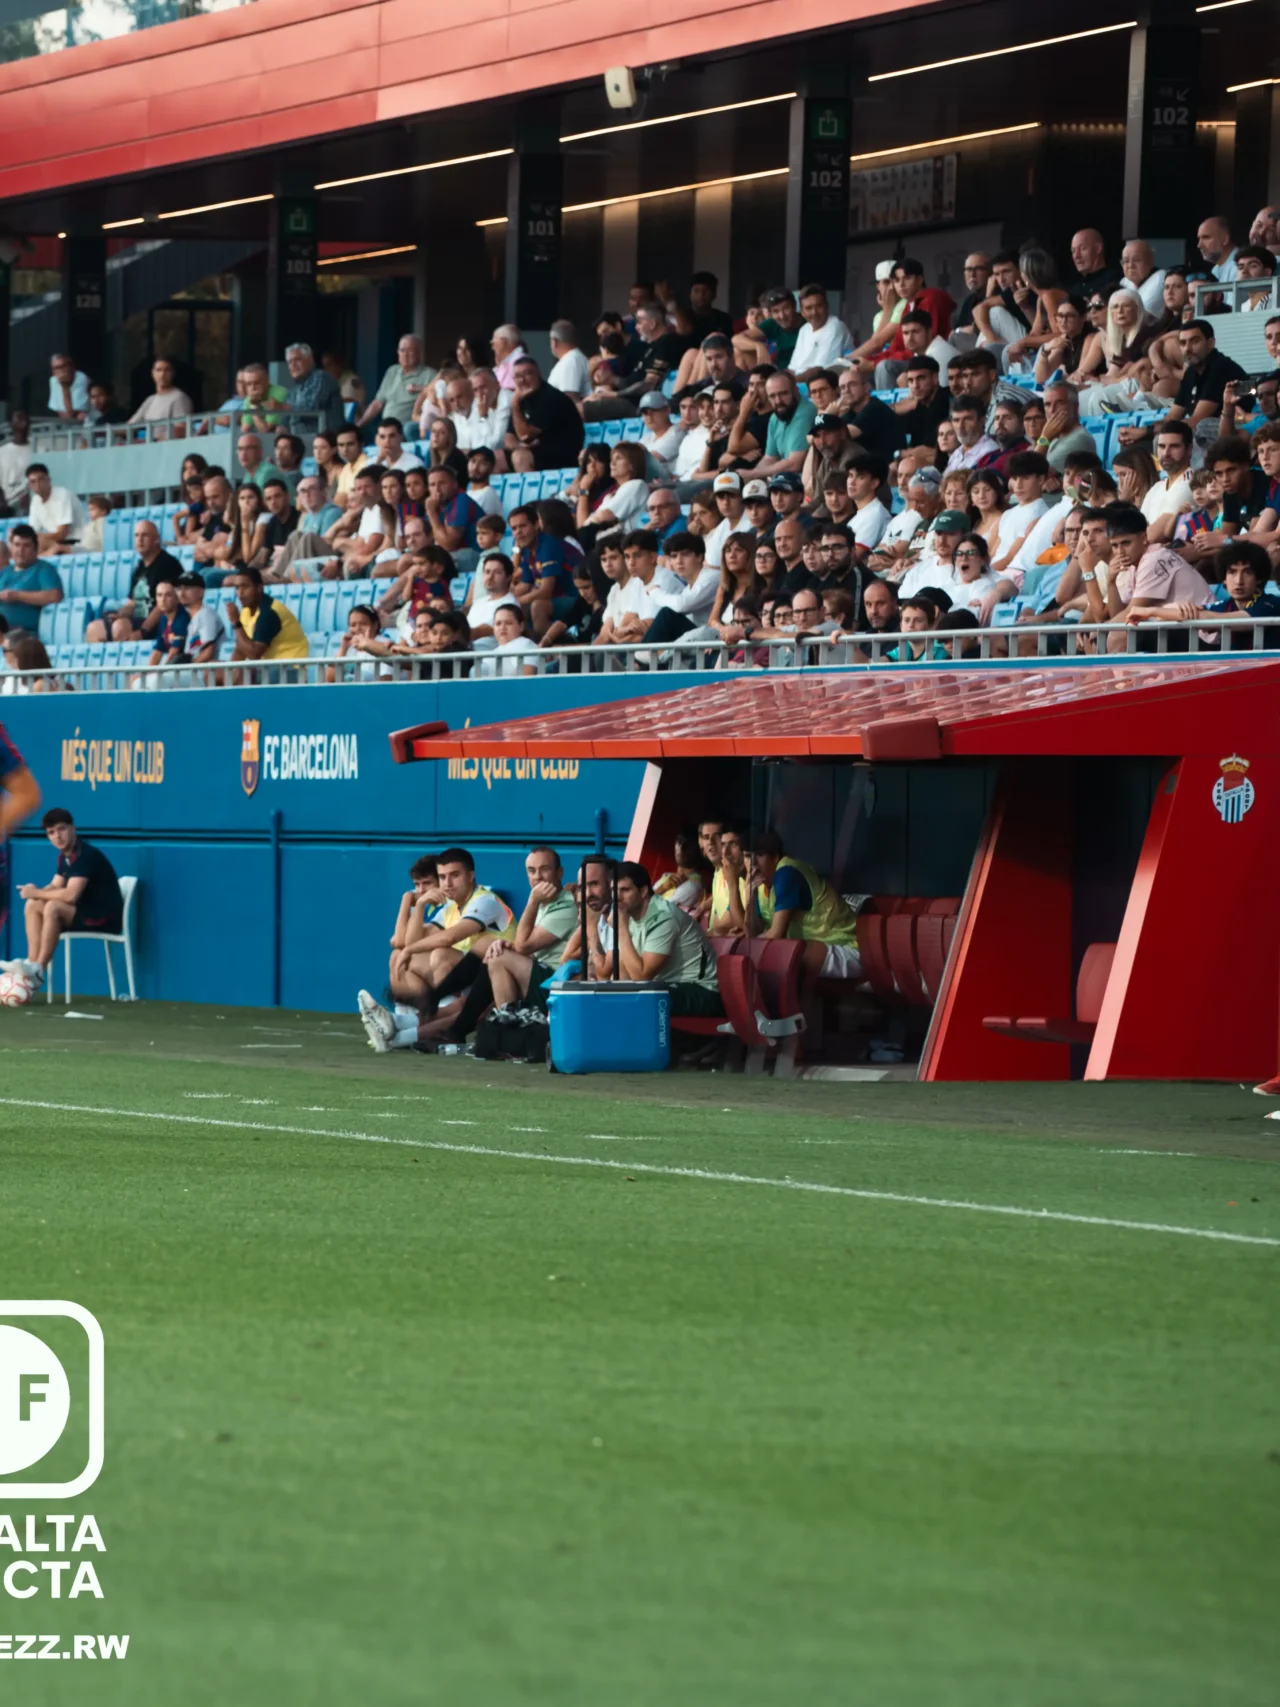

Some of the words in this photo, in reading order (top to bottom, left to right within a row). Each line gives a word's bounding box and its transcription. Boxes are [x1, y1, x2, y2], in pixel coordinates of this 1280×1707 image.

[1152, 107, 1189, 126] 102
[810, 169, 842, 188] 102
[527, 220, 556, 236] 101
[286, 259, 312, 274] 101
[60, 726, 87, 782] MÉS
[88, 739, 113, 791] QUE
[114, 740, 132, 782] UN
[133, 740, 165, 784] CLUB
[263, 734, 280, 780] FC
[280, 733, 359, 780] BARCELONA
[658, 999, 668, 1048] Coleman
